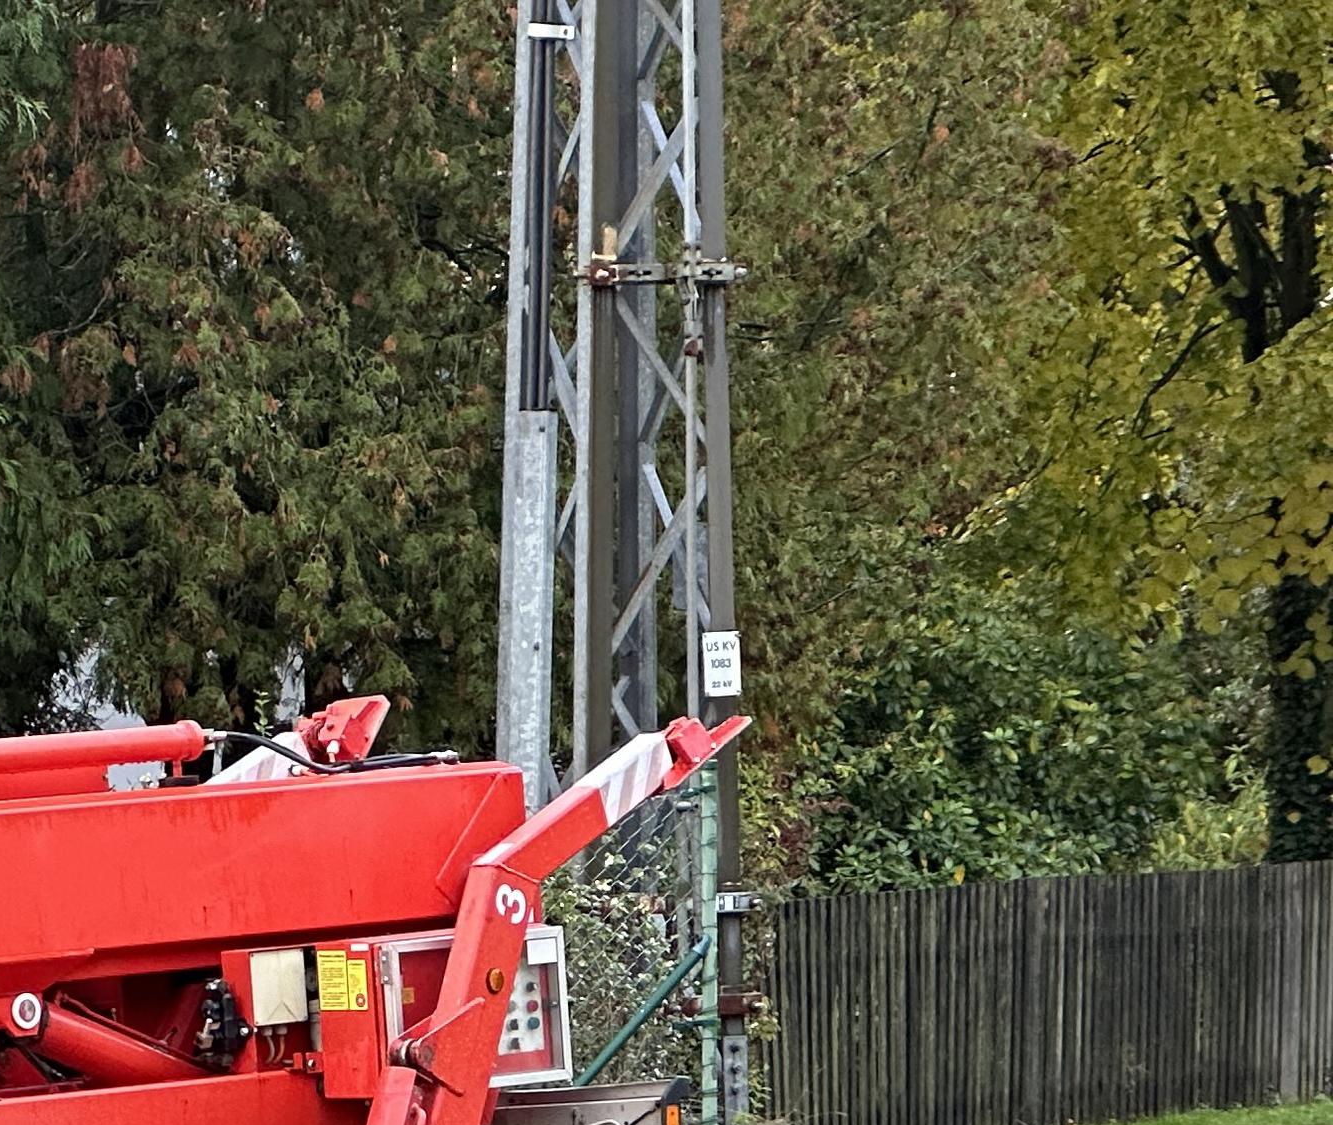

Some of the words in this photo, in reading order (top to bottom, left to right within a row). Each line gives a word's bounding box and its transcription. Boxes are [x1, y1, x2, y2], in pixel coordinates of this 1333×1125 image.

[706, 641, 719, 652] US
[722, 641, 737, 651] KV
[710, 658, 732, 669] 1083
[711, 681, 721, 689] 22
[495, 883, 527, 925] 3
